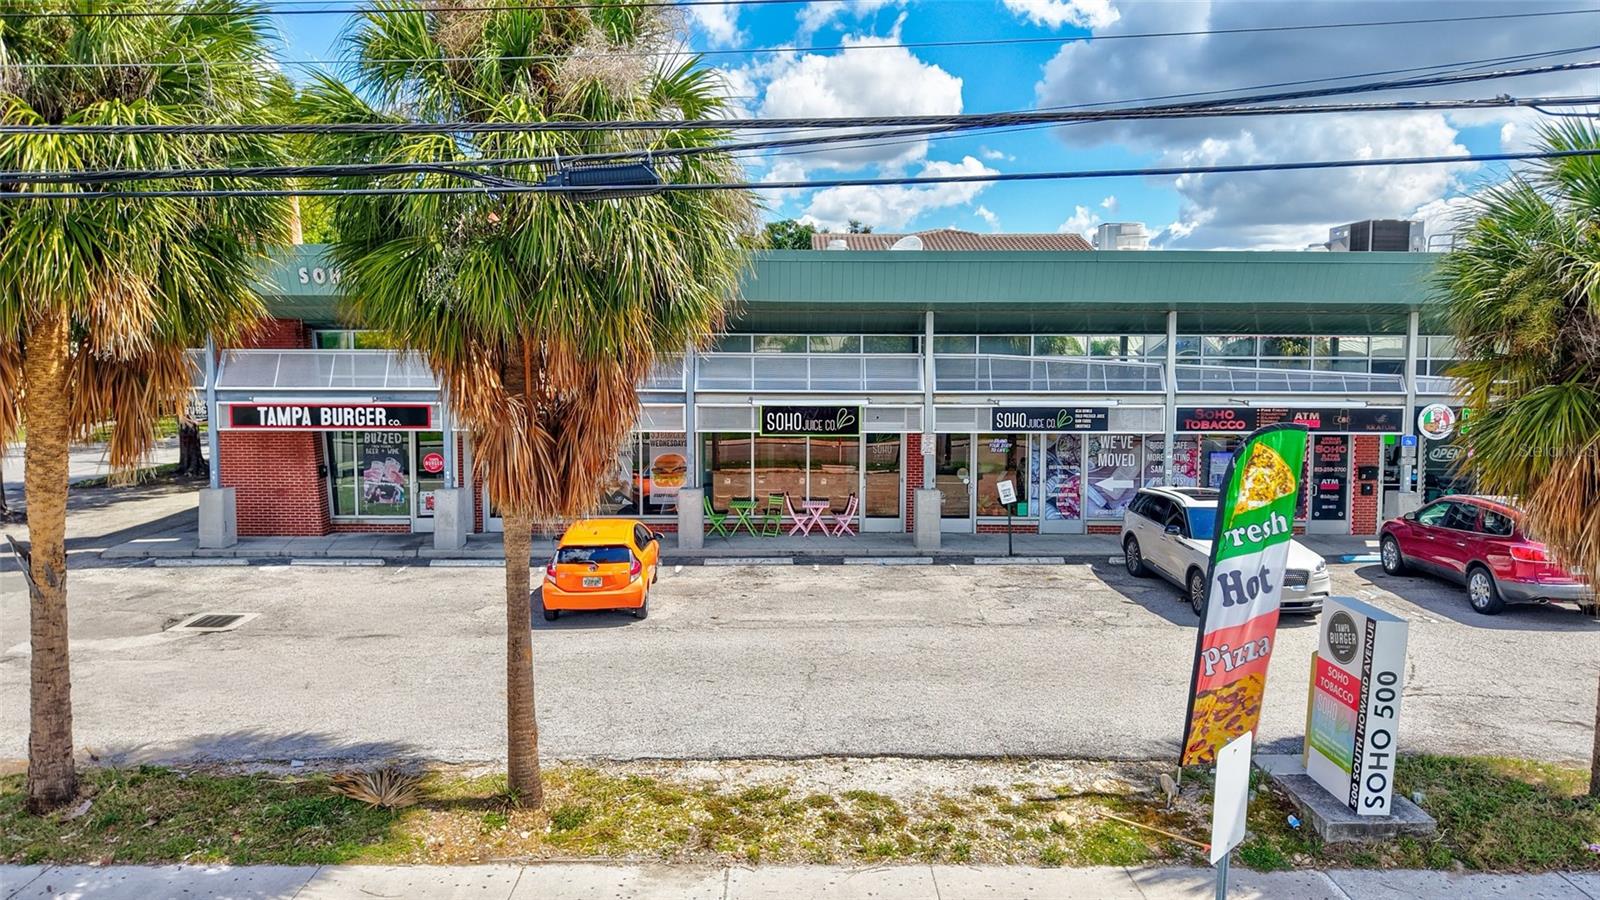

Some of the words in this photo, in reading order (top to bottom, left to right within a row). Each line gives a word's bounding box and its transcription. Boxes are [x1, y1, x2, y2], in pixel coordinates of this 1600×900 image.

[257, 406, 311, 426] TAMPA
[320, 406, 387, 426] BURGER
[388, 418, 402, 426] CO.
[766, 412, 803, 432] SOHO
[803, 419, 823, 432] JUICE
[825, 419, 837, 432] CO.
[996, 412, 1026, 428] SOHO
[1027, 418, 1045, 429] JUICE
[1046, 418, 1056, 429] CO.
[1194, 408, 1235, 419] SOHO
[1294, 412, 1320, 420] ATM
[1184, 419, 1246, 430] TOBACCO
[364, 431, 402, 444] BUZZED
[1101, 435, 1134, 449] WE'VE
[1149, 441, 1164, 449] BIGG
[1315, 445, 1346, 453] SOHO
[1431, 448, 1460, 459] OPEN
[1098, 454, 1135, 467] MOVED
[1150, 465, 1164, 474] SAM
[1173, 465, 1187, 473] REAT
[1217, 564, 1274, 608] Hot
[1335, 623, 1350, 632] TAMPA
[1329, 632, 1357, 645] BURGER
[1202, 635, 1271, 676] Pizza
[1363, 621, 1377, 675] AVENUE
[1327, 665, 1350, 686] SOHO
[1320, 676, 1354, 705] TOBACCO
[1374, 671, 1398, 720] 500
[1317, 693, 1338, 722] SOHO
[1357, 677, 1369, 735] HOWARD
[1352, 736, 1364, 781] SOUTH
[1365, 729, 1392, 809] SOHO
[1350, 783, 1360, 808] 500
